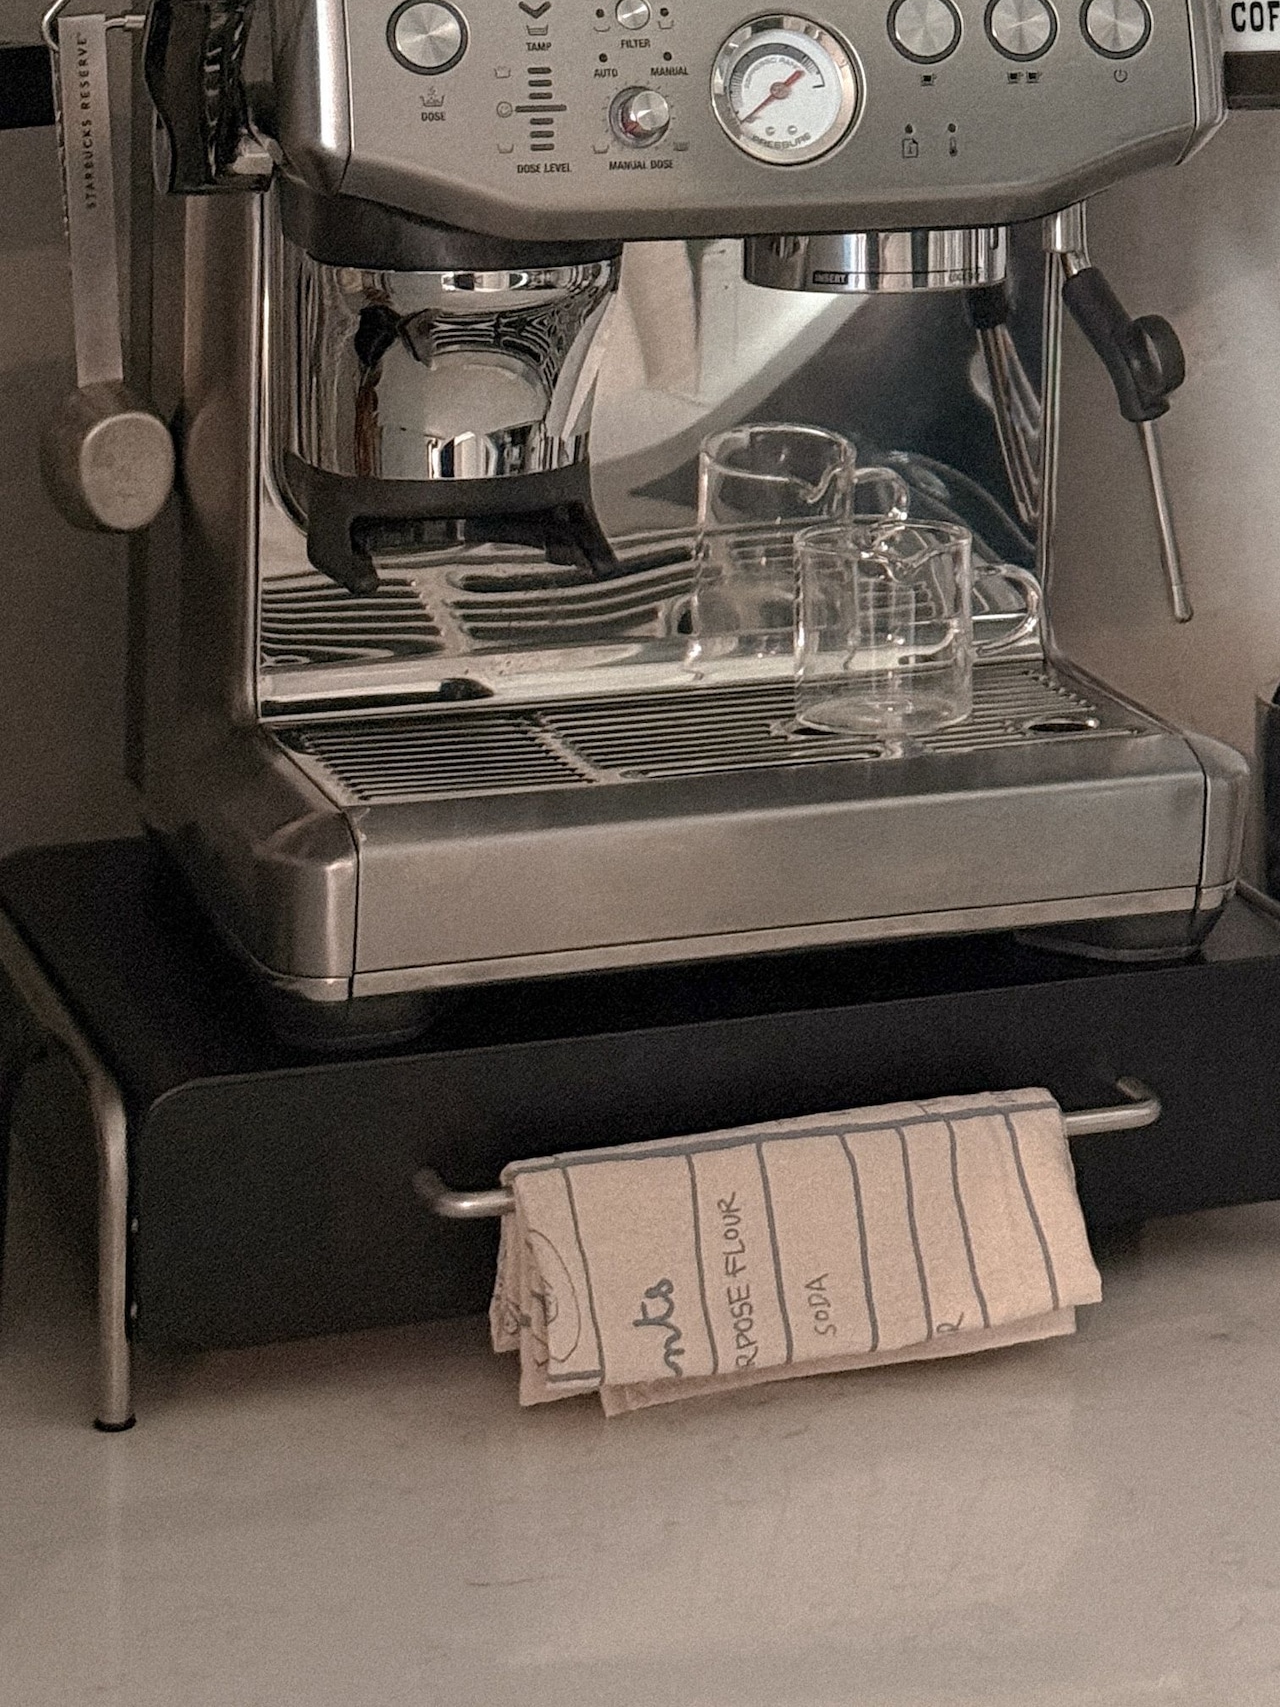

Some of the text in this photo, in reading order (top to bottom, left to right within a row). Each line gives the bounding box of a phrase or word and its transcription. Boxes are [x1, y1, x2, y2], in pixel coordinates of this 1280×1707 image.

[526, 42, 552, 52] TAMP
[620, 38, 650, 49] FILTER
[594, 68, 618, 79] AUTO
[650, 66, 689, 77] MANUAL
[421, 111, 446, 122] DOSE
[77, 37, 97, 209] STARBUCKS RESERVE
[517, 163, 572, 174] DOSE LEVEL
[609, 160, 674, 171] MANUAL DOSE
[716, 1191, 759, 1371] RPOSE FLOUR
[804, 1272, 837, 1338] SODA
[632, 1278, 687, 1377] nts
